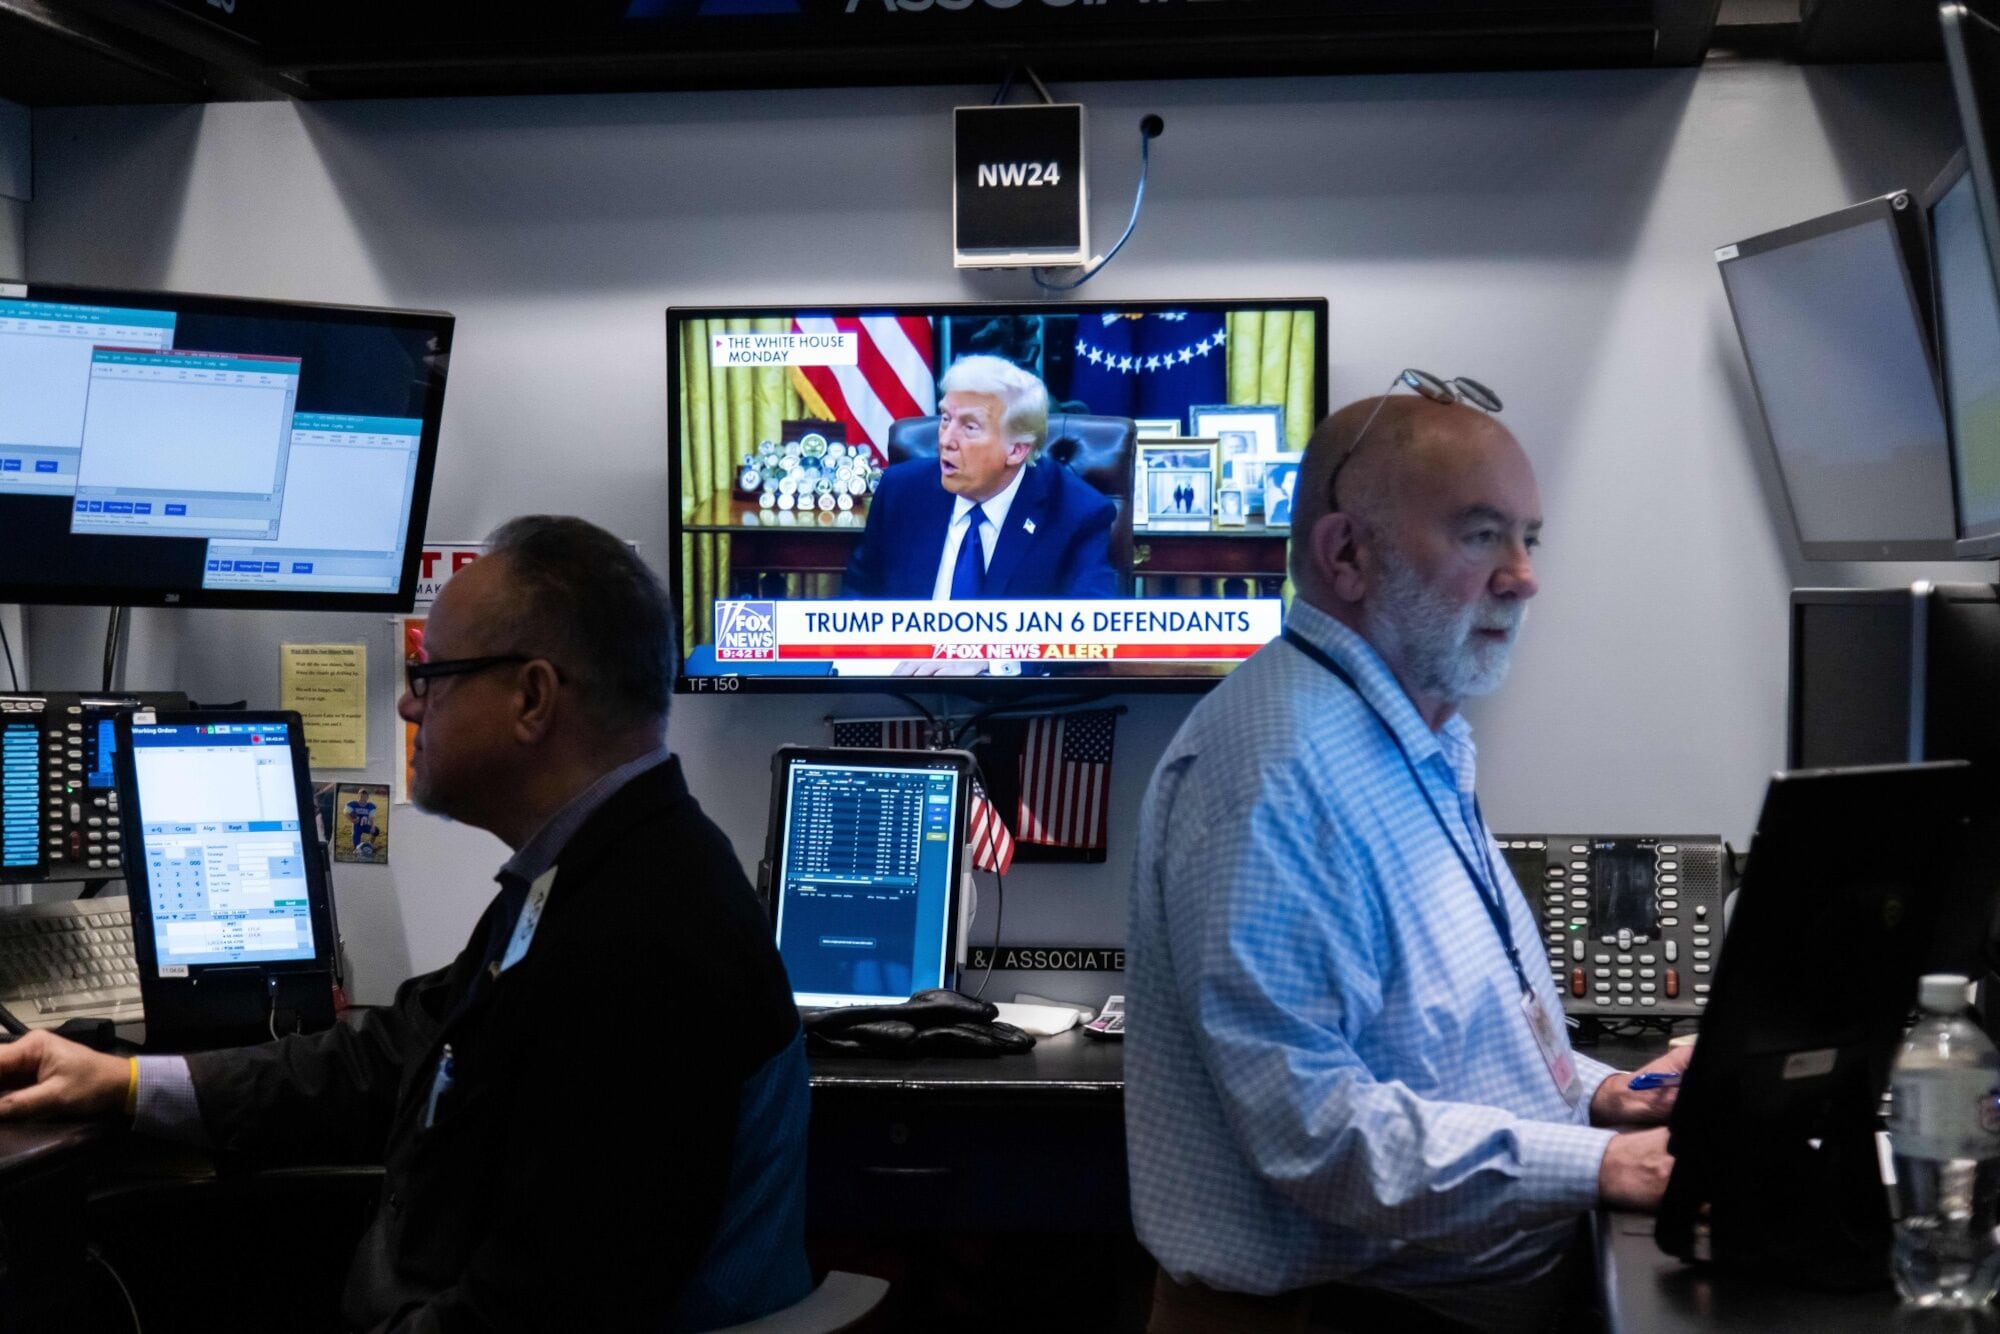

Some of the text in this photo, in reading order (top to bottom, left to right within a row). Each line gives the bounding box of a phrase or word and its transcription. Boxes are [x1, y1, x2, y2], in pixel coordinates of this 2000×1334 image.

[978, 162, 1060, 187] NW24
[728, 336, 845, 348] THE WHITE HOUSE
[728, 350, 789, 362] MONDAY
[735, 614, 771, 632] FOX
[805, 611, 1250, 633] TRUMP PARDONS JAN 6 DEFENDANTS
[725, 632, 774, 648] NEWS
[722, 649, 770, 659] 9:42 ET
[945, 644, 1118, 659] FOX NEWS ALERT
[688, 678, 739, 691] TF 150
[132, 727, 156, 735] Working
[974, 950, 988, 968] &
